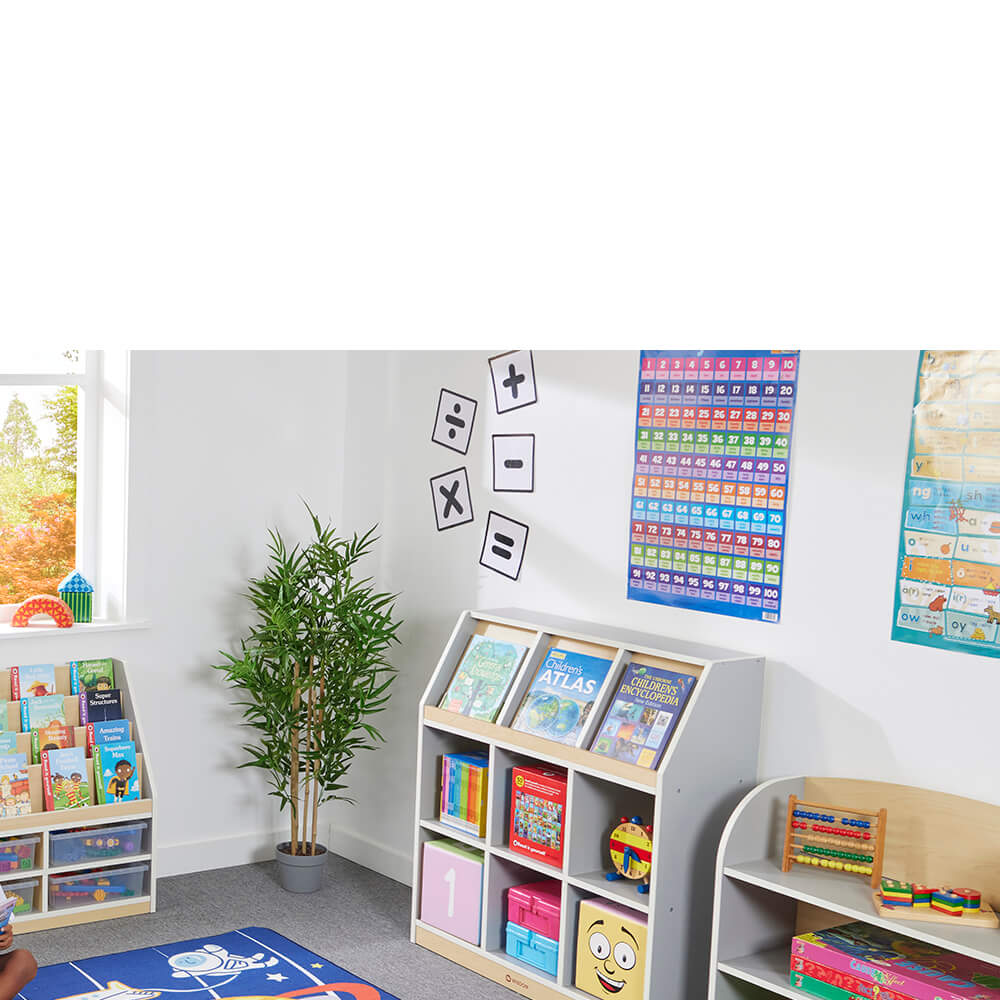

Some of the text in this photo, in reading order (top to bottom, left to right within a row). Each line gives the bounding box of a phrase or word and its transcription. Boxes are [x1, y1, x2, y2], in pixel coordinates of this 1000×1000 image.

[647, 360, 794, 369] 1 2 3 4 5 6 7 8 9 10
[642, 408, 790, 421] 21 22 23 24 25 26 27 28 29 30
[912, 487, 931, 498] ng
[911, 511, 931, 521] wh
[961, 544, 969, 552] u
[633, 569, 778, 598] 91 92 93 94 95 96 97 98 99 100
[901, 612, 967, 632] ow oy
[545, 658, 584, 676] Children's
[538, 669, 596, 695] ATLAS
[620, 684, 679, 707] ENCYCLOPEDIA
[444, 867, 456, 918] 1
